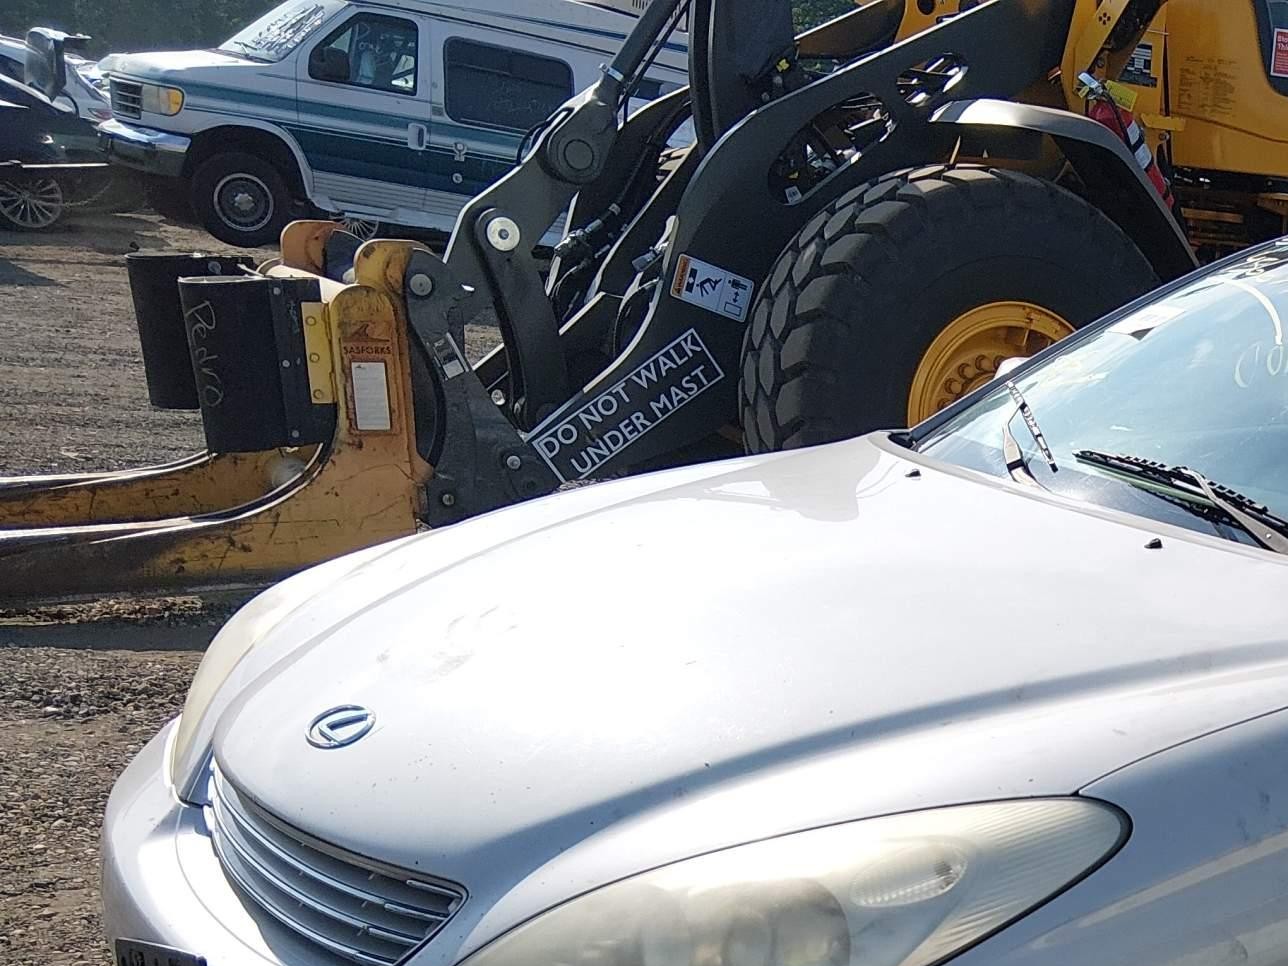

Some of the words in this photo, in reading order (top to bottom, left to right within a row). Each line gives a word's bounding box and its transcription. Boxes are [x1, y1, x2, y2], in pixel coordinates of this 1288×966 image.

[343, 345, 392, 355] SASFORKS
[539, 423, 578, 458] DO
[579, 382, 631, 431] NOT
[632, 335, 701, 389] WALK
[571, 411, 652, 474] UNDER
[650, 365, 709, 419] MAST
